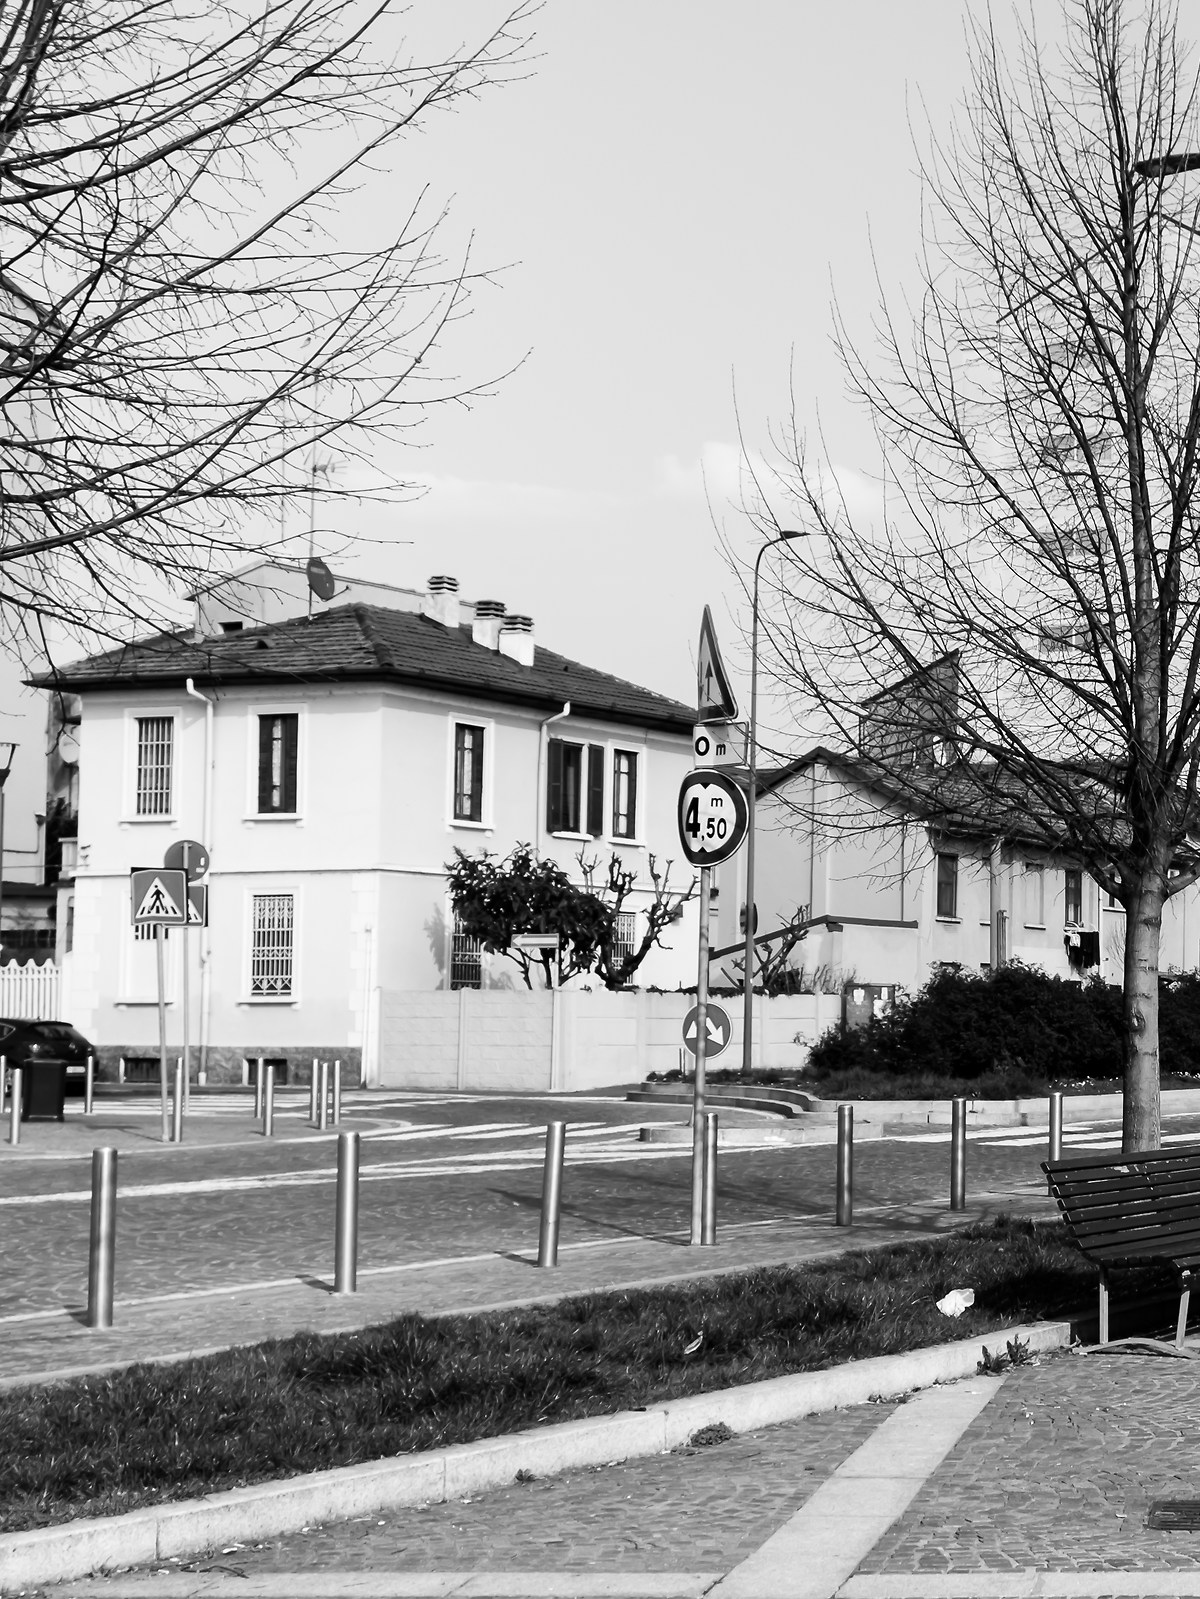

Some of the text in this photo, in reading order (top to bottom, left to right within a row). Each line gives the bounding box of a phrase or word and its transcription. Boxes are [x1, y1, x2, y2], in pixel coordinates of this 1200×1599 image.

[716, 743, 726, 756] m
[711, 797, 723, 807] m
[686, 797, 727, 841] 4,50
